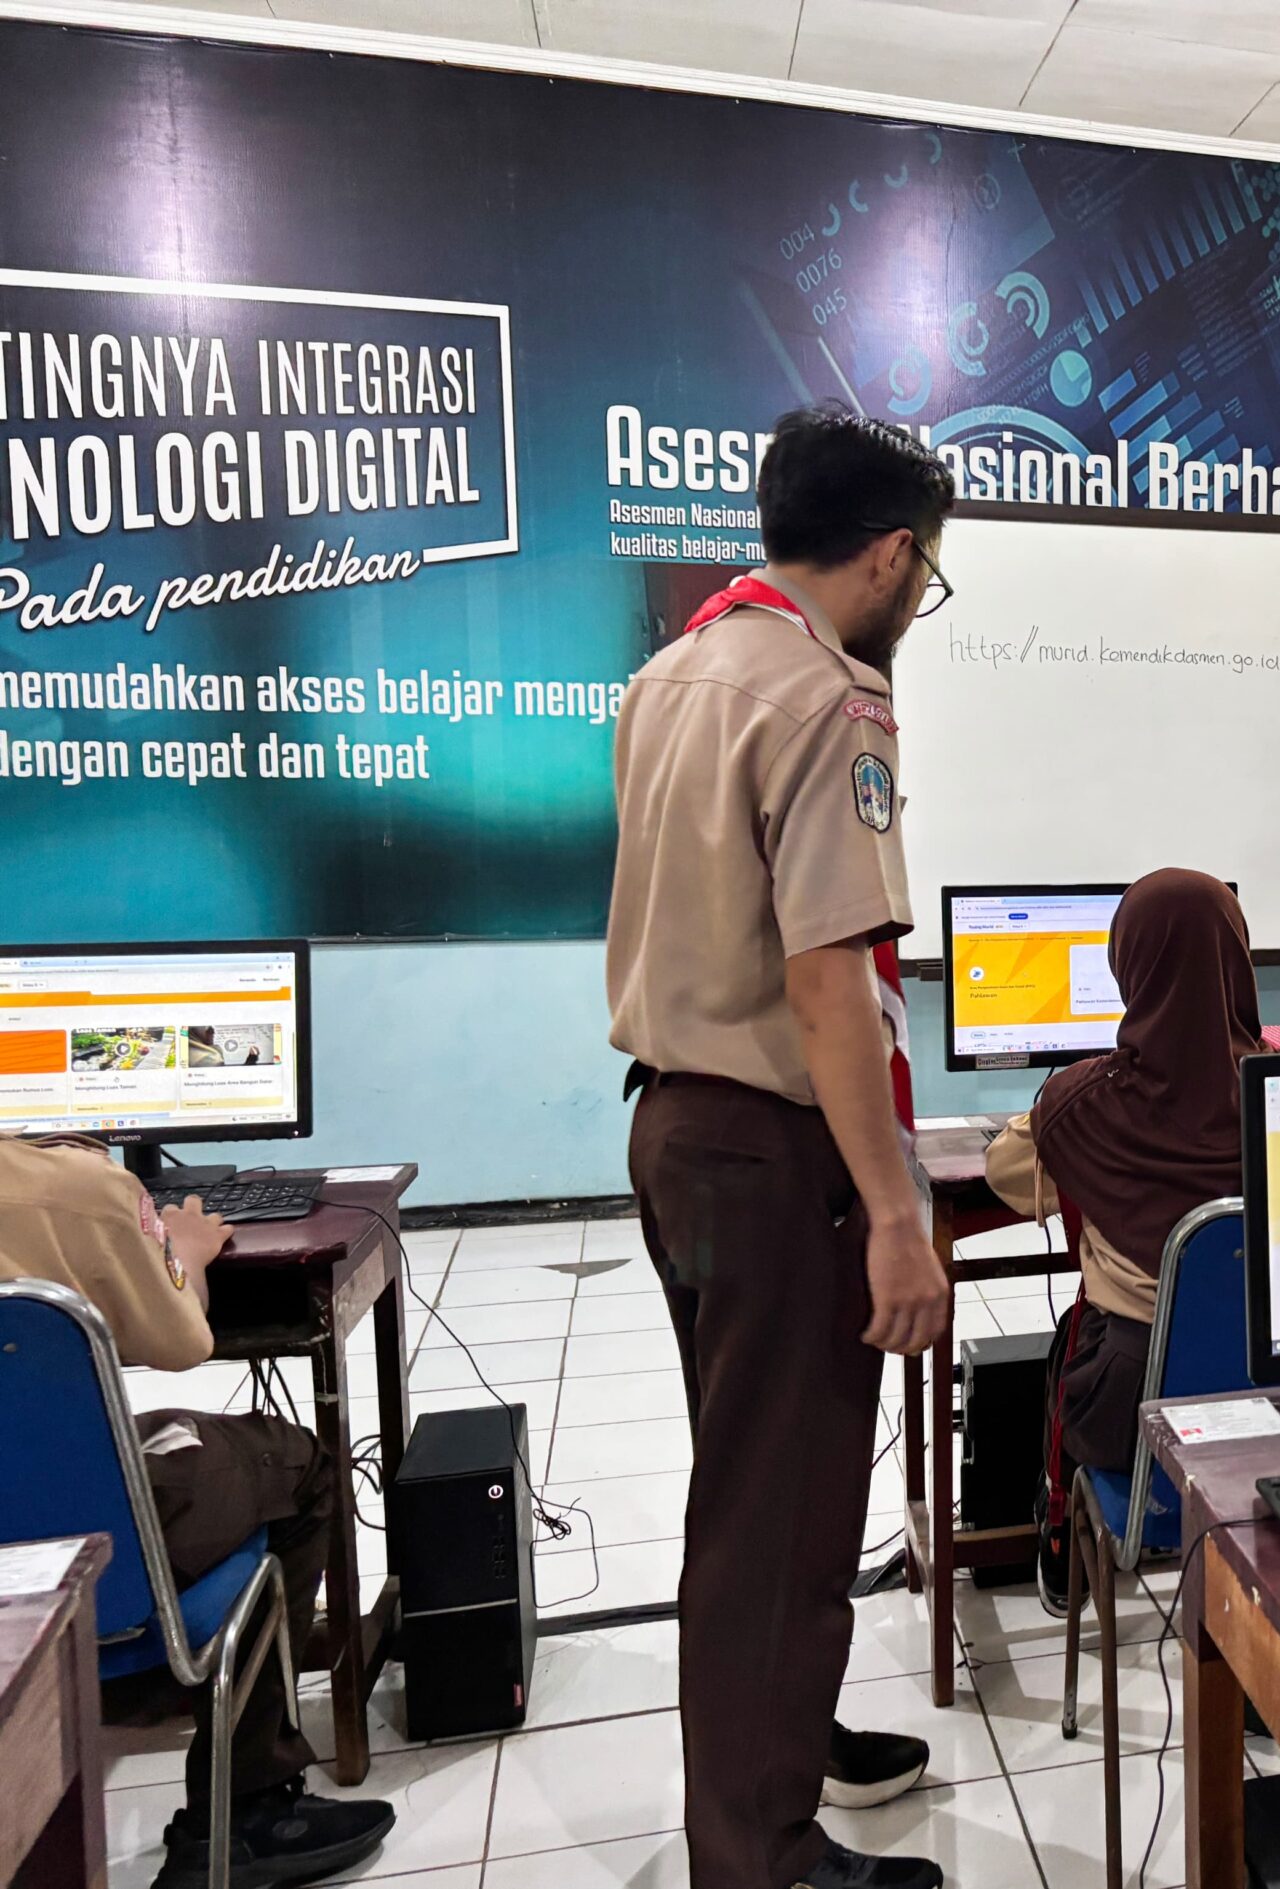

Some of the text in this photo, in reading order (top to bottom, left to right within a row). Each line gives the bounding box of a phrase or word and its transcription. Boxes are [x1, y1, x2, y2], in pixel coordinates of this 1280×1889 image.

[796, 248, 842, 292] 0076
[813, 288, 847, 325] 045
[258, 339, 476, 416] INTEGRASI
[8, 426, 480, 540] NOLOGI DIGITAL
[610, 499, 762, 529] Asesmen Nasional
[611, 531, 677, 558] kualitas
[145, 536, 421, 632] pendidikan
[257, 666, 365, 714] akses
[378, 669, 502, 722] belajar
[514, 674, 634, 725] menga
[142, 732, 248, 786] cepat
[259, 733, 325, 780] dan
[336, 734, 430, 787] tepat
[109, 1134, 142, 1143] Lenovo
